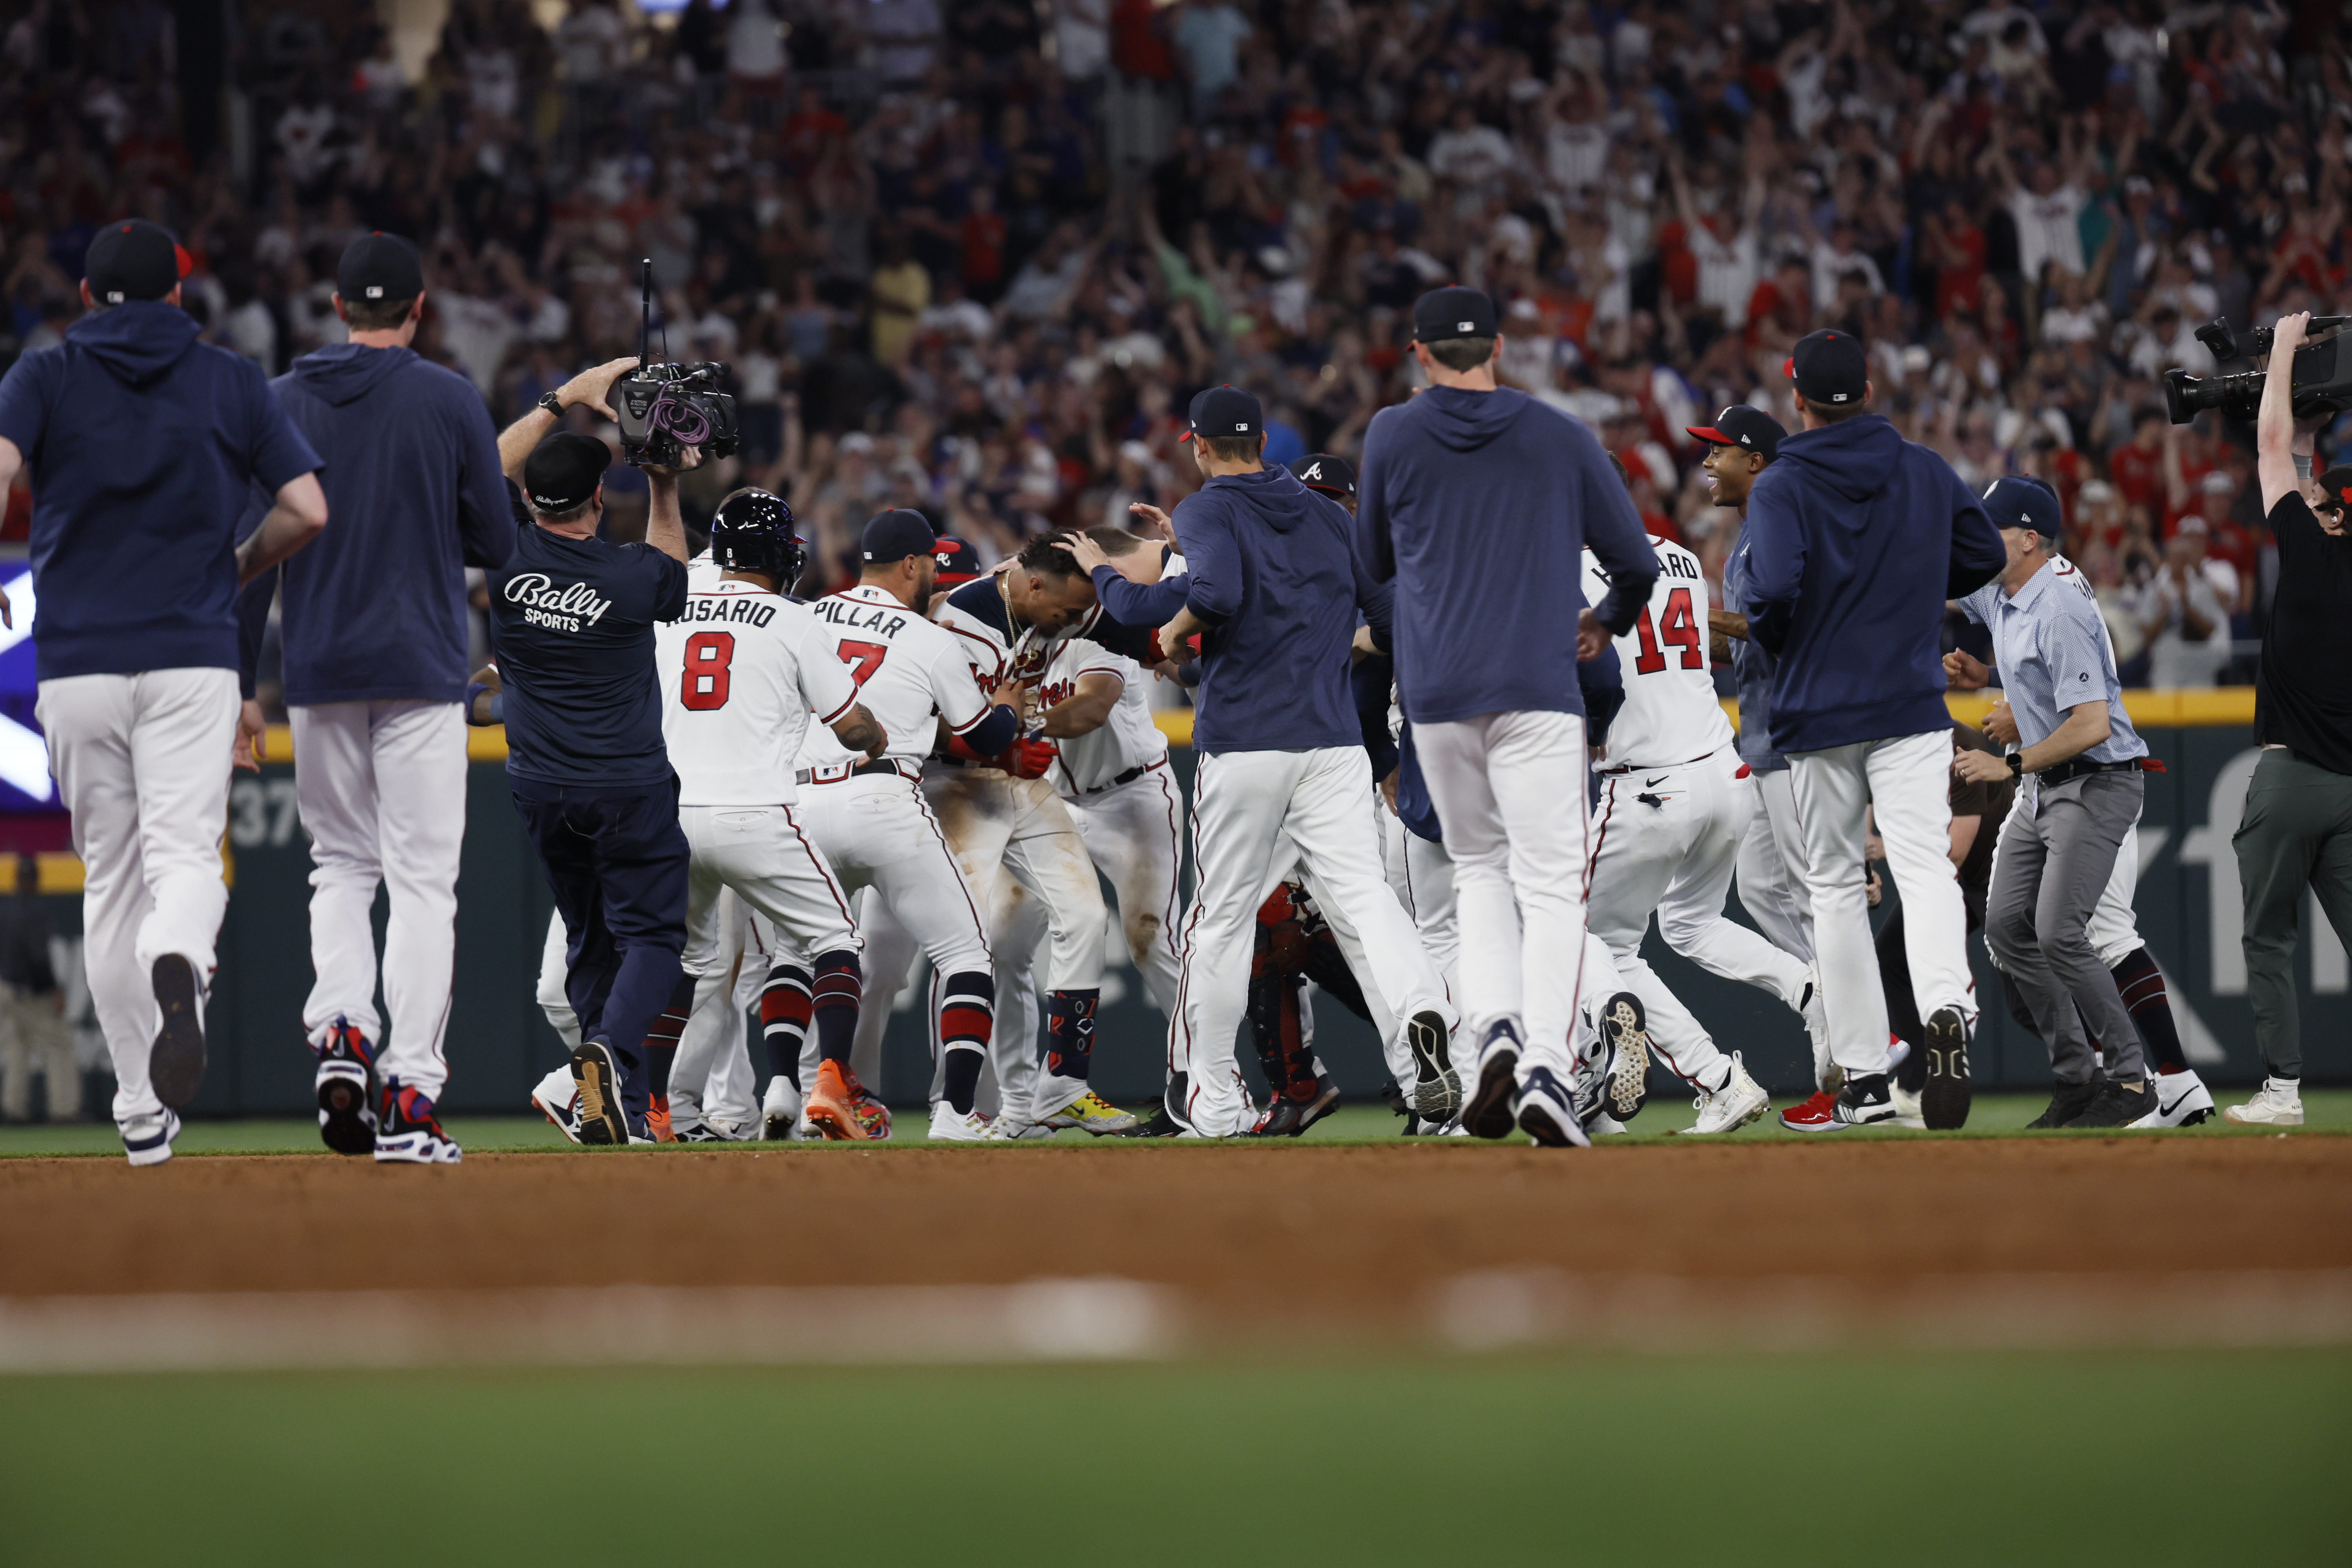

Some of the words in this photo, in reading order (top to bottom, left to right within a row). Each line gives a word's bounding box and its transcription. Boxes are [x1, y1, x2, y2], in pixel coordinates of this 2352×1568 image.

[1300, 462, 1322, 480] A
[727, 548, 732, 558] 8
[504, 573, 612, 626] Bally
[666, 599, 776, 628] OSARIO
[524, 608, 580, 632] SPORTS
[814, 601, 906, 639] PILLAR
[1635, 588, 1703, 675] 14
[681, 631, 735, 711] 8
[837, 639, 888, 688] 7
